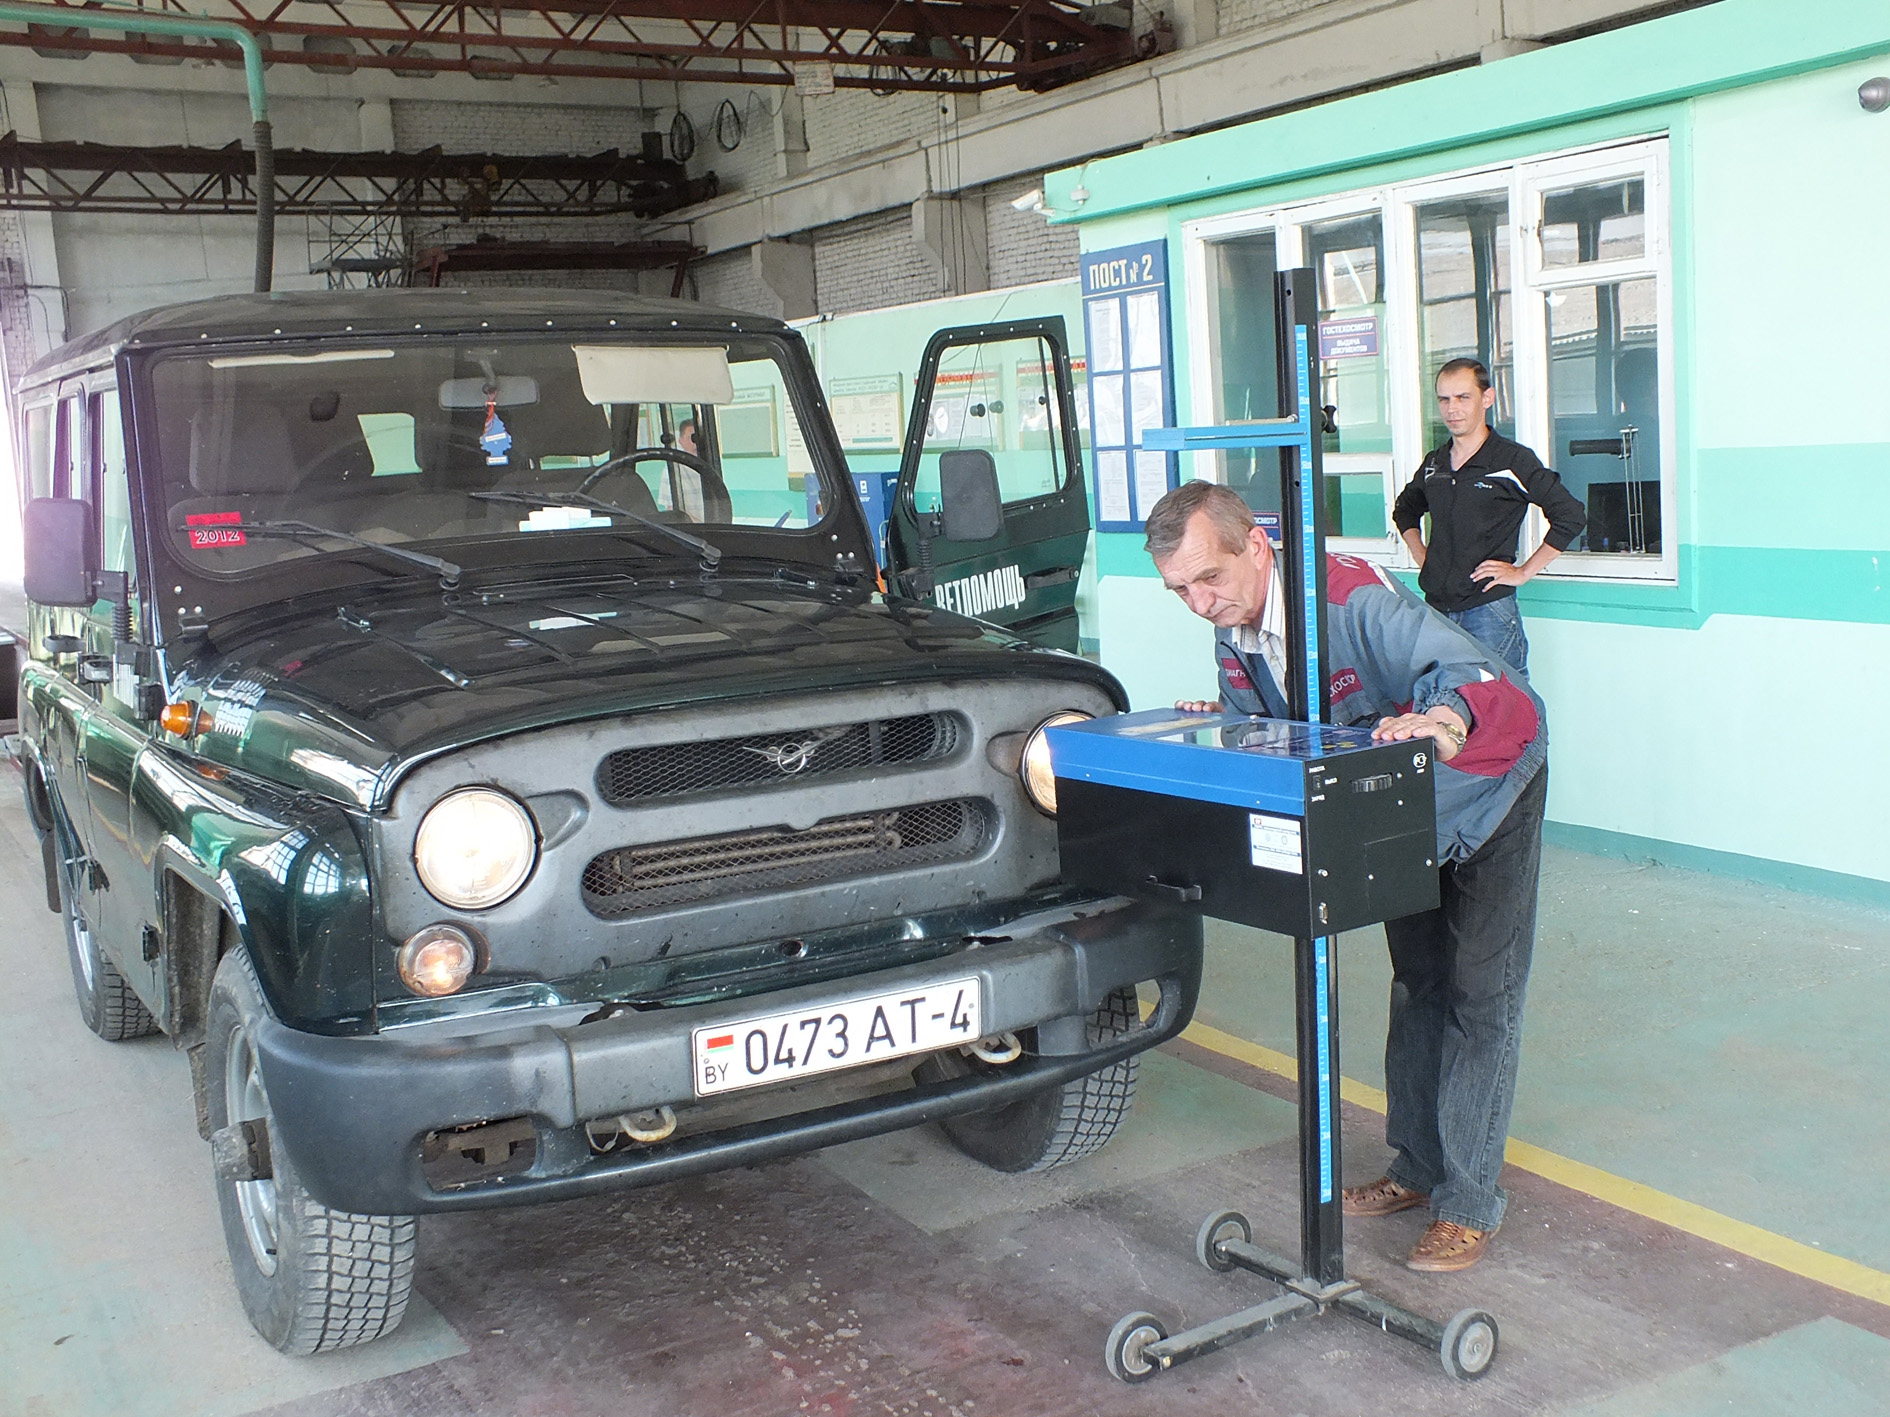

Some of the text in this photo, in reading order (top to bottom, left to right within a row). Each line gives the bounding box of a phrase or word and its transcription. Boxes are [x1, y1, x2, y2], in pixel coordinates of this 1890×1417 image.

[1089, 259, 1127, 290] ПОСТ
[1141, 254, 1153, 281] 2
[1322, 322, 1374, 335] ГОСТЕХОСМОТР
[195, 529, 240, 544] 2012
[934, 564, 1026, 617] ВЕТПОМОЩЬ
[744, 989, 971, 1075] 0473 AT-4
[704, 1063, 729, 1084] BY
